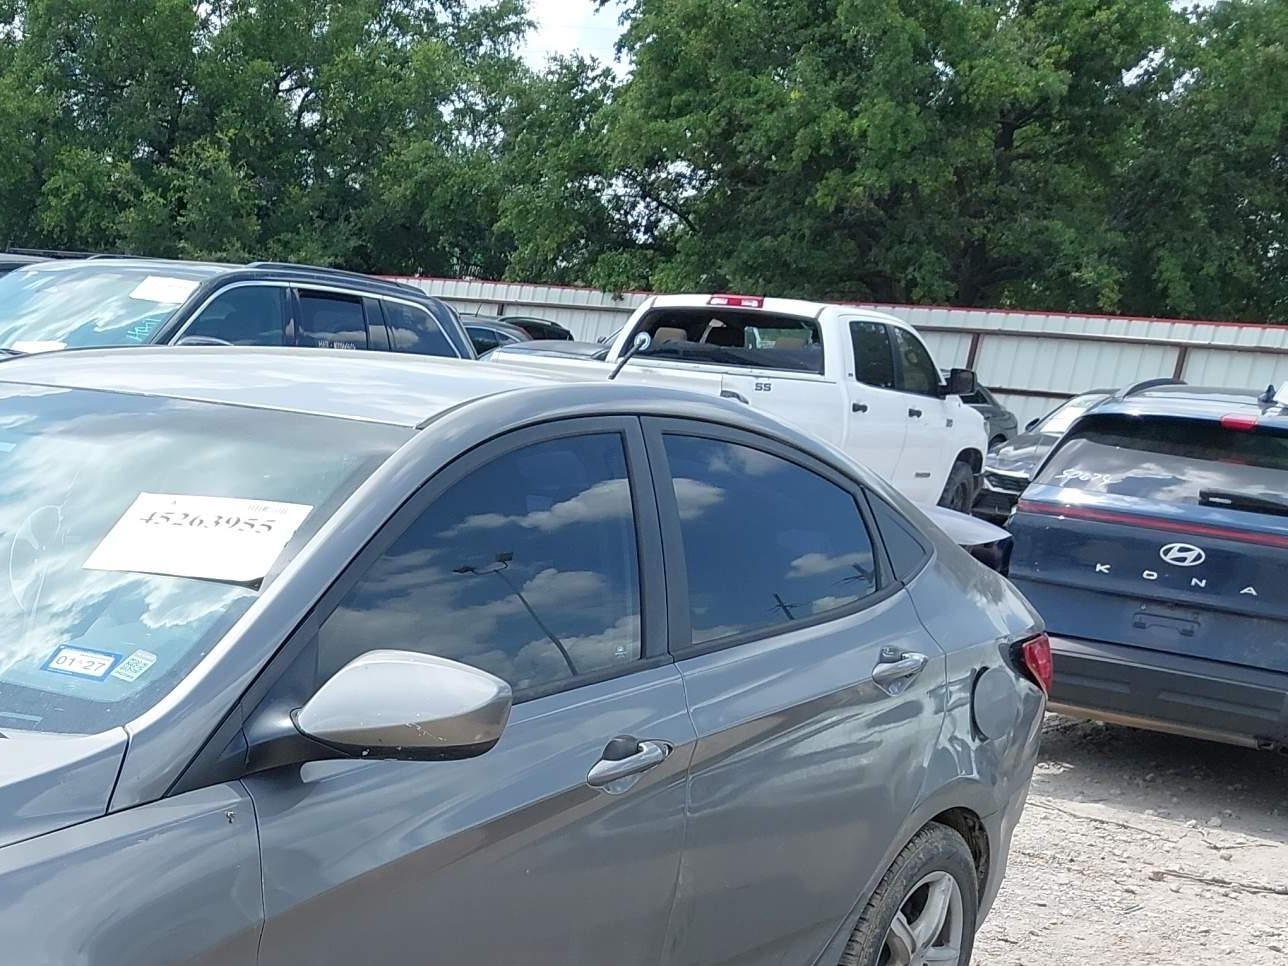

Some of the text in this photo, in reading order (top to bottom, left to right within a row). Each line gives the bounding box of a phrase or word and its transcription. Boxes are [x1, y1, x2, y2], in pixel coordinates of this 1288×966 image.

[754, 382, 772, 392] SS
[140, 511, 276, 534] 45263955
[1095, 562, 1258, 596] KONA
[82, 660, 106, 673] 27
